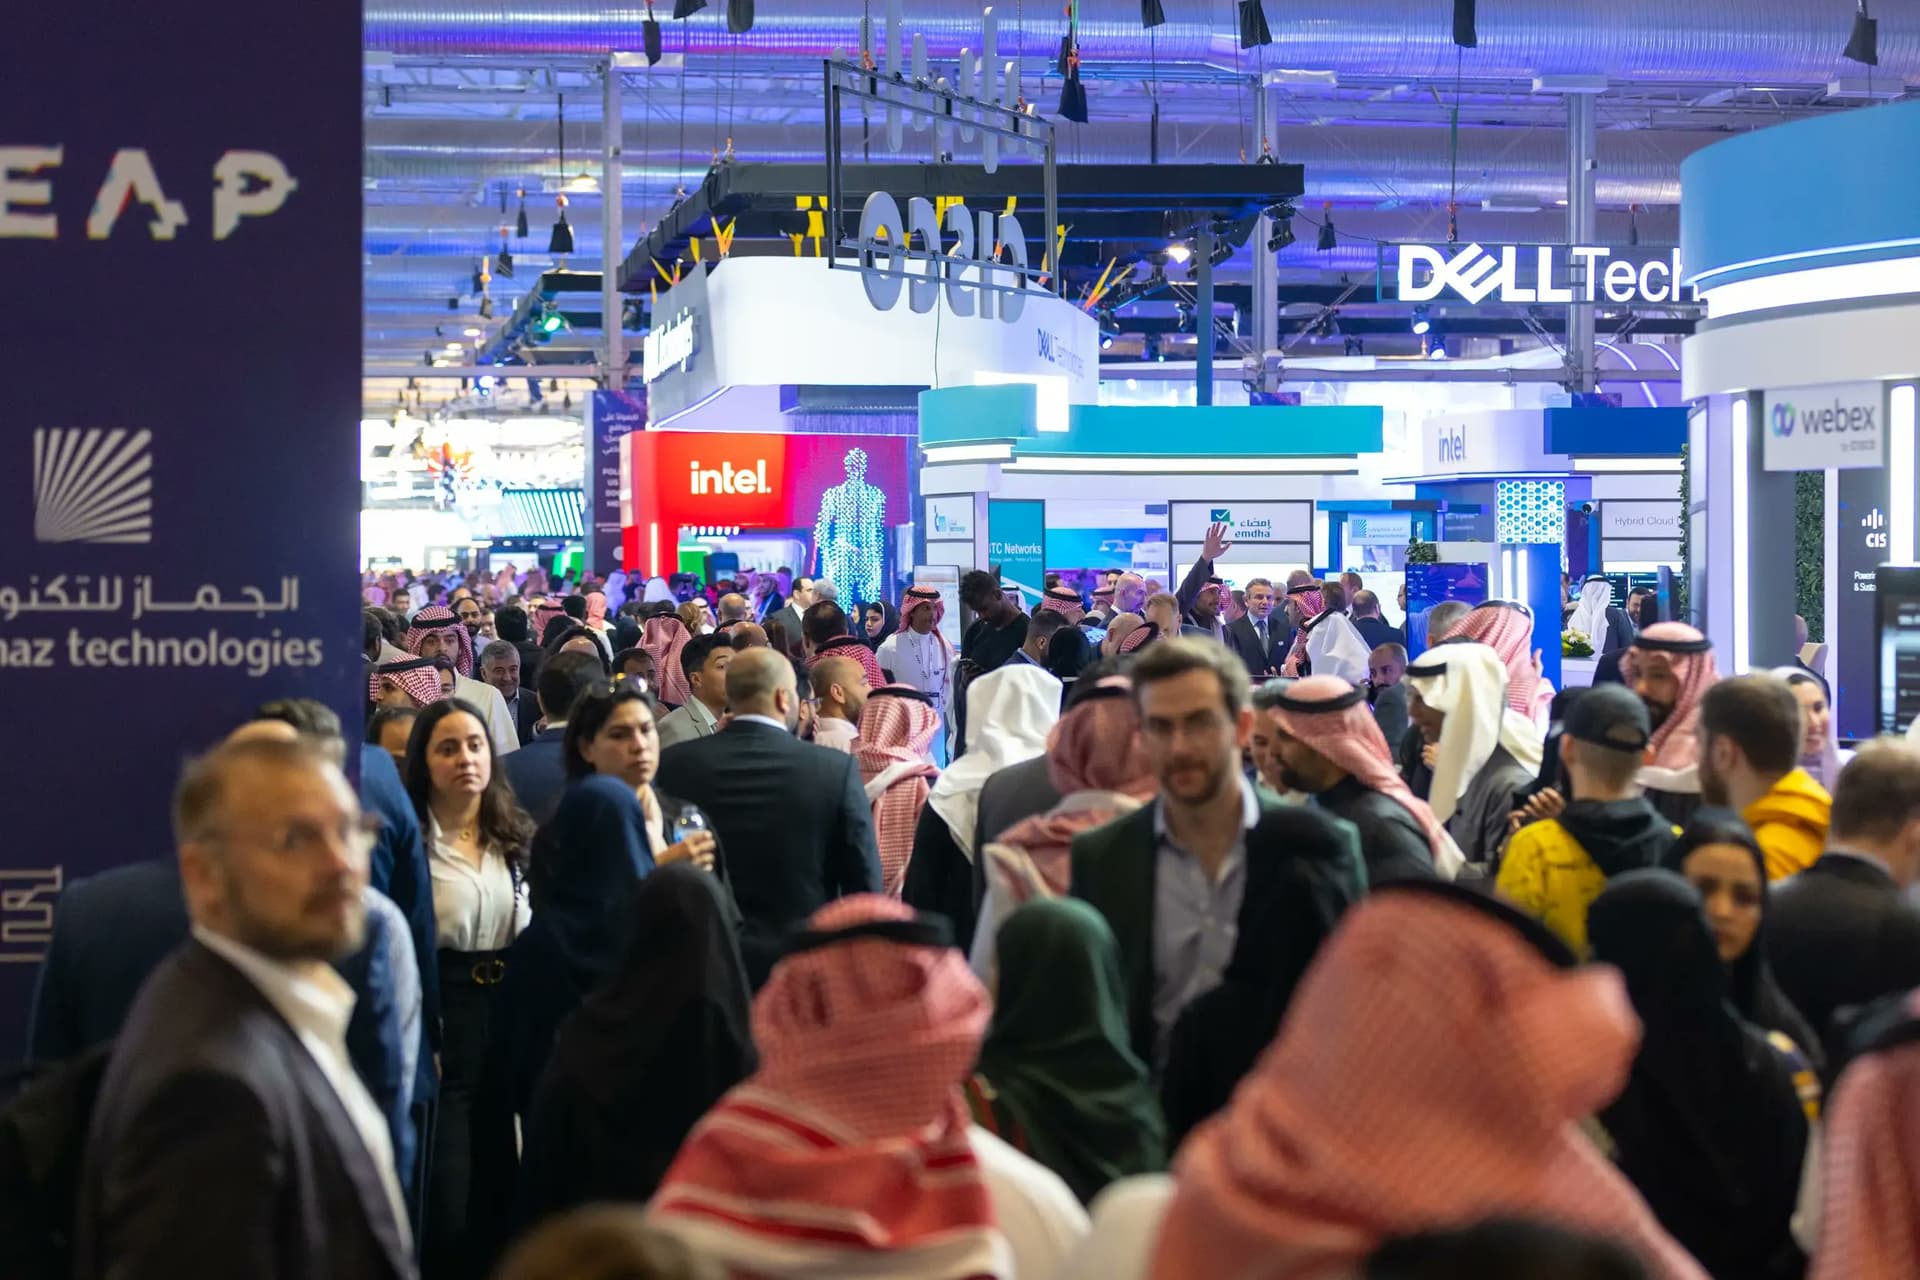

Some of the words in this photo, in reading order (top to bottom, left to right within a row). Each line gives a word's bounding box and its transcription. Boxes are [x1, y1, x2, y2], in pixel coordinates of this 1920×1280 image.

[1397, 242, 1572, 304] DELL
[1801, 396, 1876, 434] webex
[1235, 528, 1270, 538] emdha
[1615, 516, 1644, 527] Hybrid
[1646, 516, 1674, 526] Cloud
[1004, 542, 1042, 554] Networks
[67, 627, 324, 678] technologies
